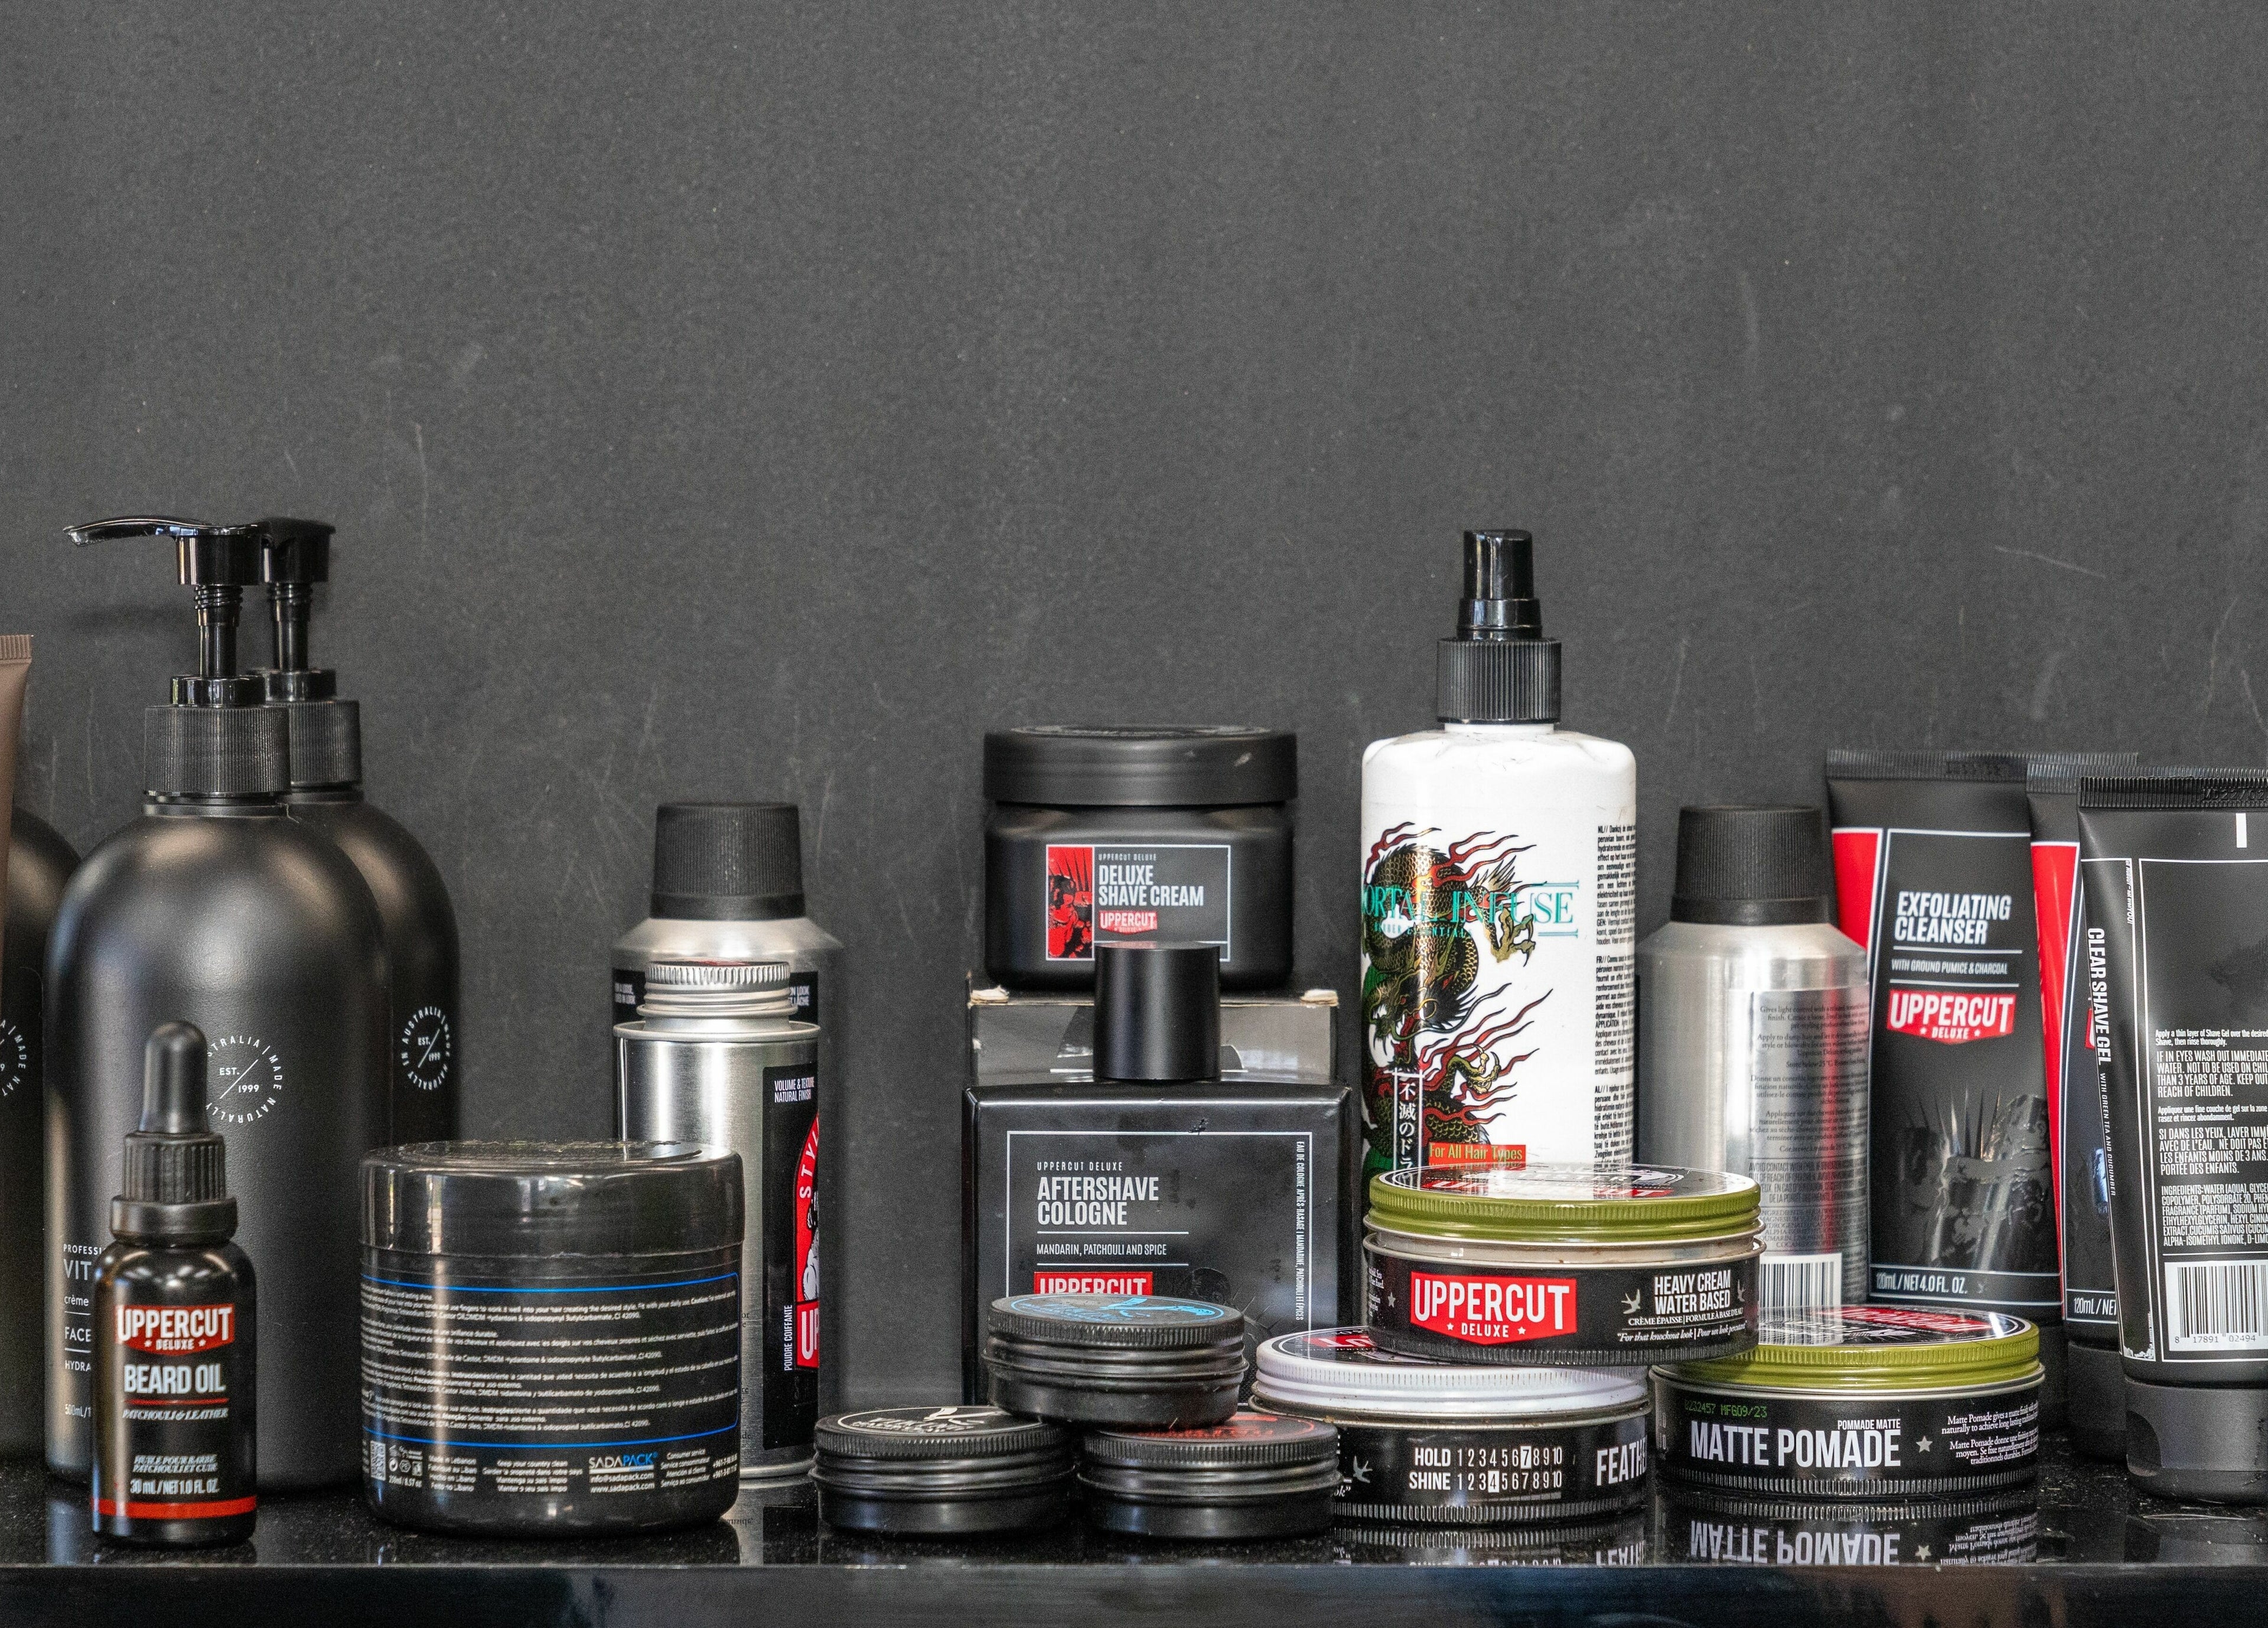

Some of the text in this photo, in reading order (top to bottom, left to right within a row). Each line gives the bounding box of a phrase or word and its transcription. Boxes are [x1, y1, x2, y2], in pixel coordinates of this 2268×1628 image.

[1099, 865, 1153, 885] DELUXE
[1099, 885, 1204, 906] SHAVE CREAM
[1451, 891, 1573, 924] INFUSE
[1897, 891, 2012, 920] EXFOLIATING
[1100, 912, 1156, 929] UPPERCUT
[1894, 916, 1988, 945] CLEANSER
[1892, 959, 2008, 975] WITH GROUND PUMICE & CHARCOAL
[2088, 928, 2111, 1066] CLEAR SHAVE GEL
[1891, 993, 2013, 1033] UPPERCUT
[402, 1006, 441, 1044] AUSTRALIA
[1931, 1027, 1969, 1040] DELUXE
[418, 1036, 431, 1046] EST.
[14, 1034, 27, 1069] MADE
[2156, 1051, 2163, 1062] IF
[2166, 1051, 2174, 1062] IN
[2176, 1050, 2193, 1062] EYES
[2194, 1050, 2215, 1062] WASH
[2217, 1050, 2230, 1062] OUT
[219, 1067, 240, 1076] EST.
[2156, 1063, 2185, 1074] WATER.
[2186, 1062, 2202, 1073] NOT
[2202, 1062, 2210, 1073] TO
[2212, 1062, 2221, 1073] BE
[2222, 1062, 2240, 1073] USED
[2241, 1062, 2251, 1073] ON
[774, 1079, 796, 1090] VOLUME
[797, 1079, 801, 1089] &
[2157, 1073, 2268, 1086] THAN 3 YEARS OF AGE. KEEP OUT
[206, 1054, 282, 1123] MADE NATURALLY
[238, 1084, 259, 1093] 1999
[774, 1089, 812, 1103] NATURAL FINISH
[2158, 1085, 2233, 1098] REACH OF CHILDREN.
[1296, 1141, 1305, 1152] EAU
[1429, 1143, 1523, 1161] For All Hair Types
[1037, 1162, 1122, 1171] UPPERCUT DELUXE
[1296, 1163, 1305, 1187] COLOGNE
[2107, 1154, 2116, 1196] CUCUMBER
[2161, 1162, 2240, 1176] PORTEE DES ENFANTS.
[1037, 1177, 1159, 1201] AFTERSHAVE
[1038, 1202, 1128, 1225] COLOGNE
[63, 1243, 105, 1255] PROFESSI
[1037, 1244, 1166, 1256] MANDARIN, PATCHOULI AND SPICE
[1295, 1235, 1305, 1267] MANDARINE,
[1295, 1268, 1304, 1295] PATCHOULI
[1654, 1269, 1731, 1295] HEAVY CREAM
[1903, 1273, 1920, 1291] NET
[1920, 1275, 1936, 1292] 4.0
[1936, 1276, 1949, 1293] FL.
[1951, 1277, 1968, 1294] OZ.
[64, 1294, 89, 1307] crème
[1415, 1278, 1569, 1330] UPPERCUT
[1655, 1290, 1731, 1315] WATER BASED
[1295, 1303, 1305, 1320] ÉPICES
[1628, 1314, 1713, 1326] CRÈME ÉPAISSE FORMULE
[118, 1307, 233, 1342] UPPERCUT
[1461, 1322, 1509, 1338] DELUXE
[64, 1327, 92, 1342] FACE
[784, 1305, 793, 1371] POUDRE COIFFANTE
[1634, 1332, 1648, 1342] that
[1650, 1330, 1680, 1341] knockout
[1680, 1330, 1693, 1339] look
[155, 1339, 194, 1350] DELUXE
[124, 1363, 226, 1394] BEARD OIL
[1837, 1419, 1901, 1430] POMMADE MATTE
[1947, 1411, 2005, 1425] Matte Pomade gives
[1941, 1425, 1970, 1435] naturally
[1979, 1421, 1998, 1431] achieve
[1691, 1421, 1901, 1468] MATTE POMADE
[1415, 1447, 1562, 1467] HOLD 1 2 3 4 5 6 7 8 9 10
[1409, 1471, 1562, 1490] SHINE 1 2 3 4 5 6 7 8 9 10
